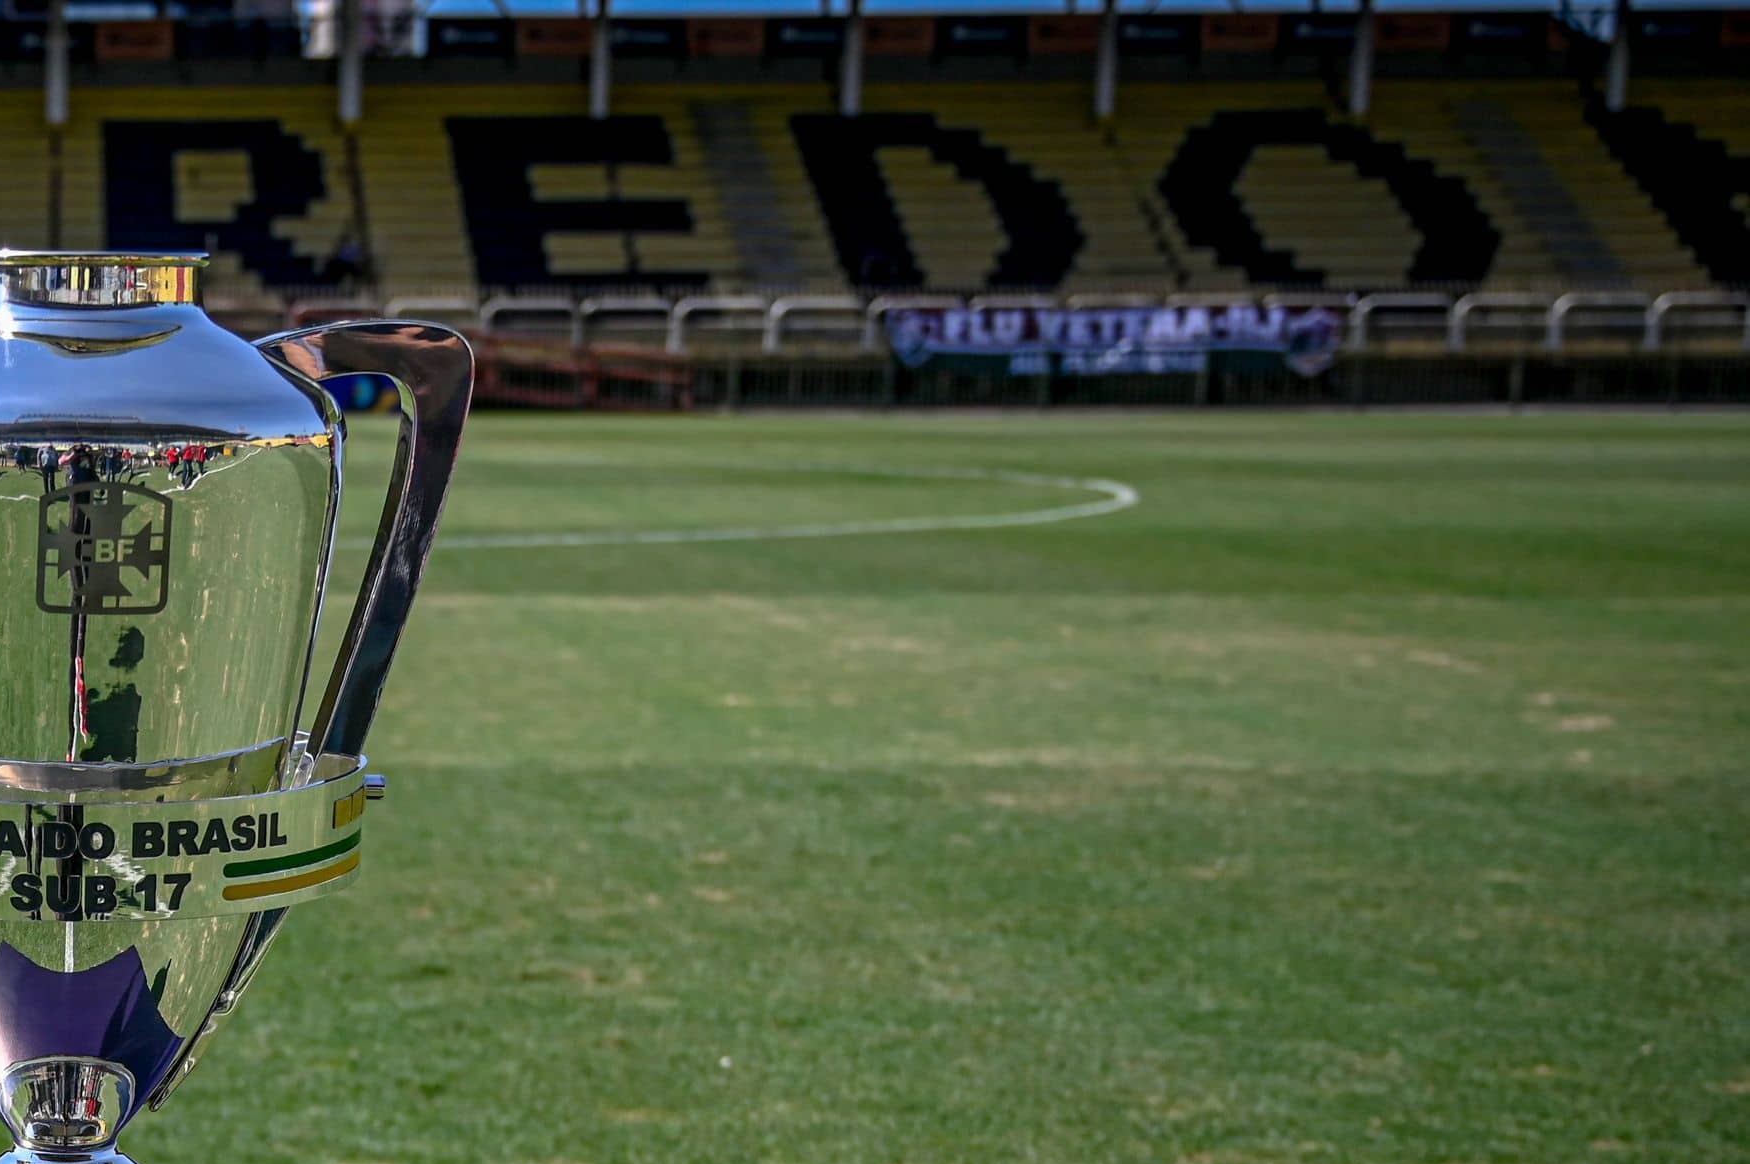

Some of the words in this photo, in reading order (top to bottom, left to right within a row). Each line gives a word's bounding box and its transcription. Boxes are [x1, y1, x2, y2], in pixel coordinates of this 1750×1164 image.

[75, 538, 135, 563] CBF
[42, 821, 115, 860] DO
[131, 812, 288, 858] BRASIL
